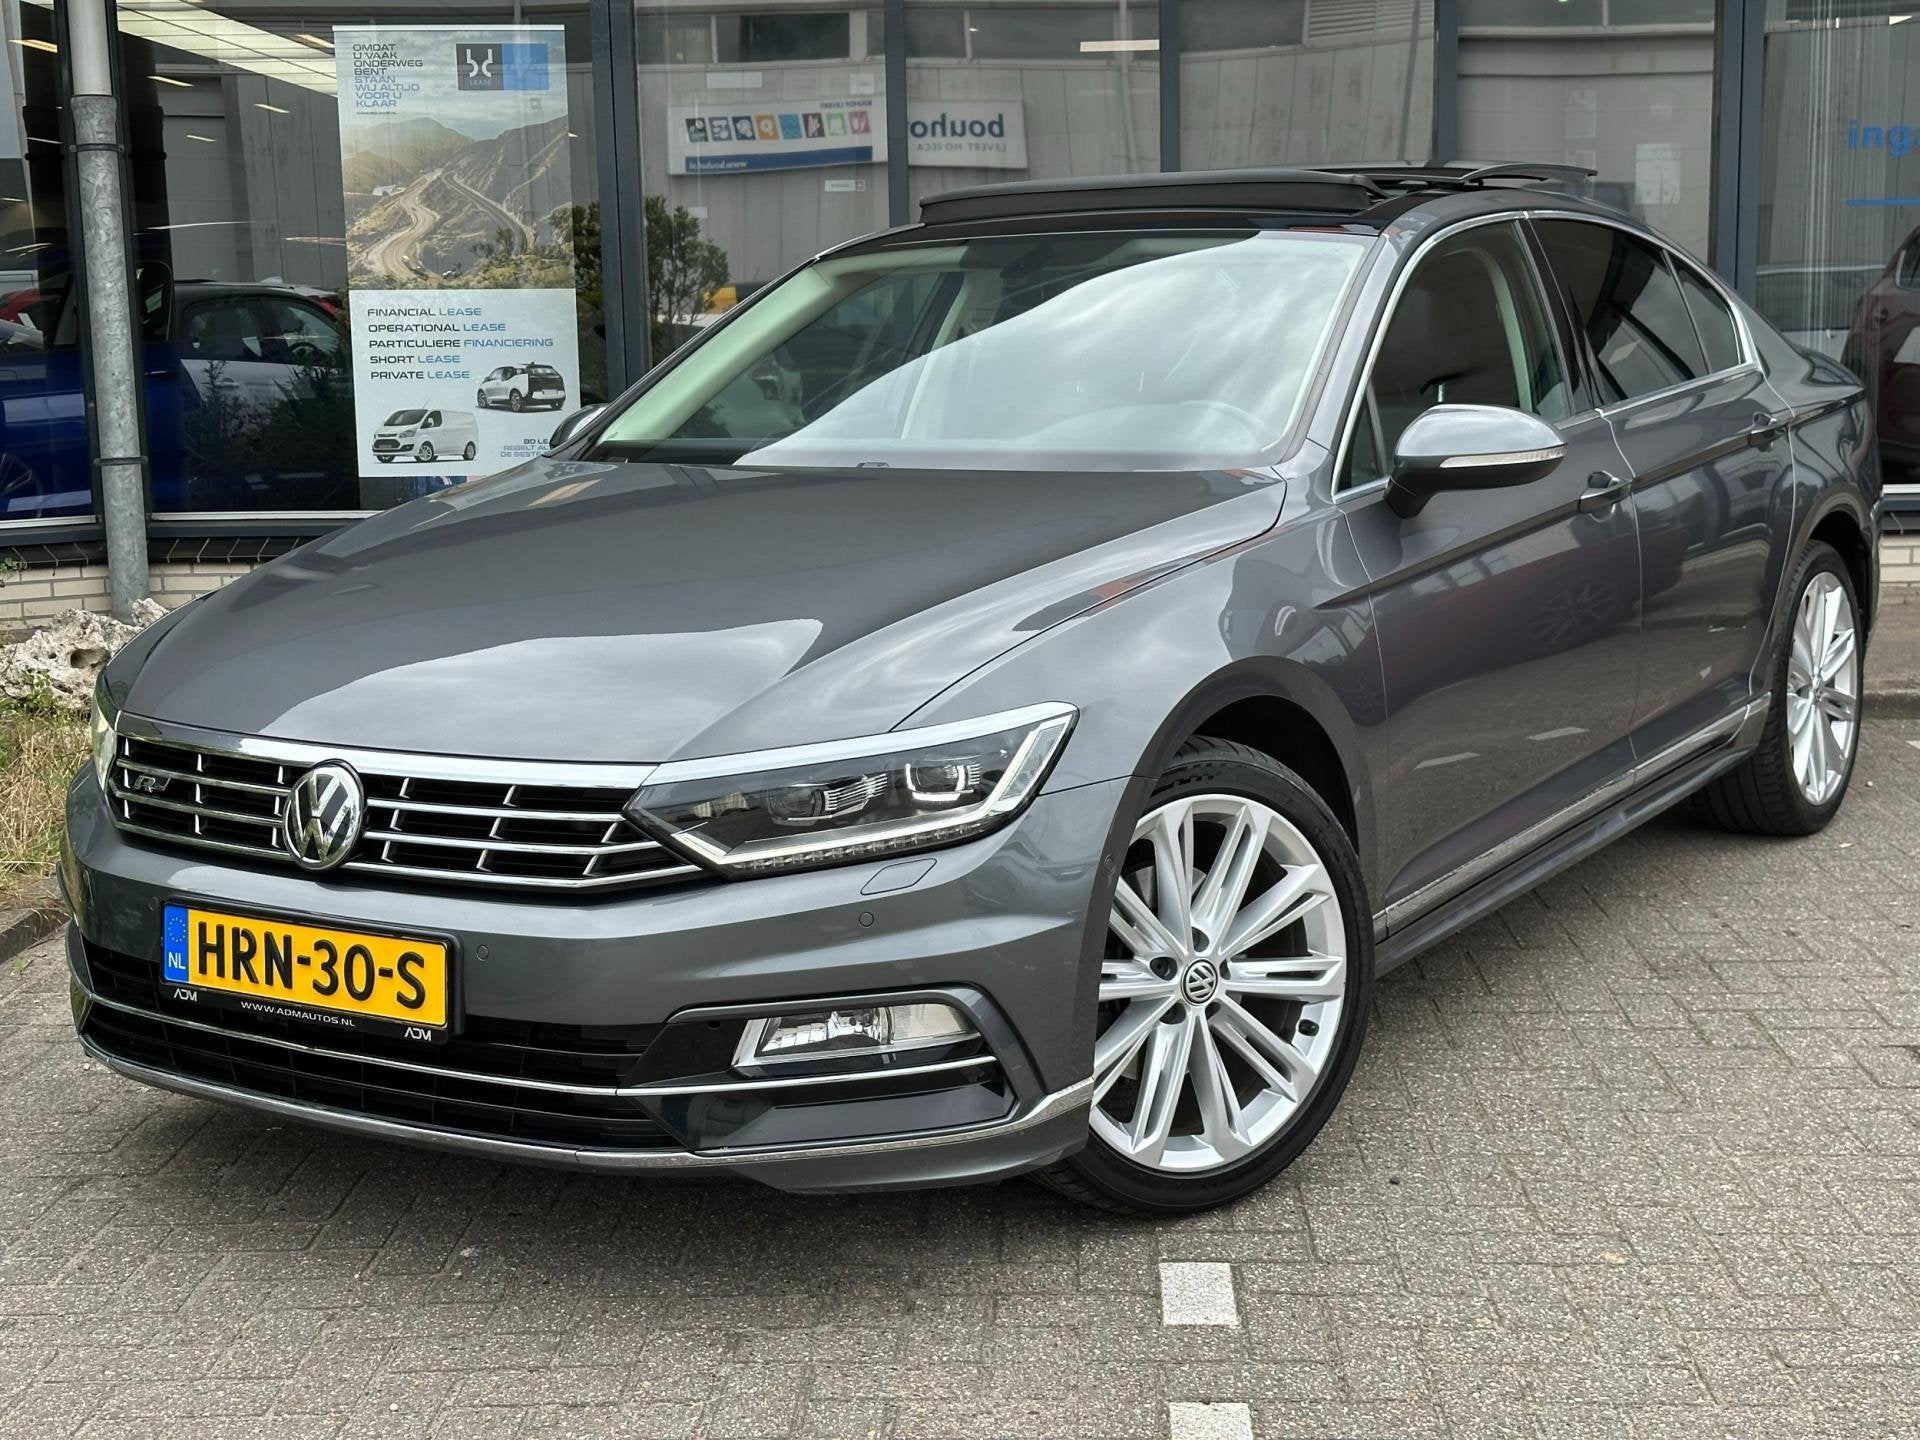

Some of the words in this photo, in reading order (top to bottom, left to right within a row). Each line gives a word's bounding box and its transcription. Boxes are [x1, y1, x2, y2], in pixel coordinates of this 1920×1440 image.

[352, 43, 396, 52] OMDAT
[364, 51, 398, 60] VAAK
[353, 59, 424, 67] ONDERWEG
[354, 67, 387, 75] BENT
[354, 75, 396, 83] STAAN
[355, 83, 377, 91] WIJ
[380, 83, 420, 92] ALTIJD
[355, 91, 390, 100] VOOR
[393, 91, 402, 99] U
[356, 99, 397, 108] KLAAR
[1847, 119, 1920, 157] ing
[367, 307, 436, 317] FINANCIAL
[439, 307, 481, 316] LEASE
[368, 324, 460, 332] OPERATIONAL
[463, 323, 506, 331] LEASE
[369, 339, 461, 348] PARTICULIERE
[464, 338, 553, 347] FINANCIERING
[370, 355, 414, 364] SHORT
[418, 355, 460, 363] LEASE
[370, 371, 424, 380] PRIVATE
[427, 370, 470, 379] LEASE
[168, 952, 186, 970] NL
[198, 920, 426, 1010] HRN-30-S
[240, 1000, 356, 1028] WWW.ADMAUTOS.NL
